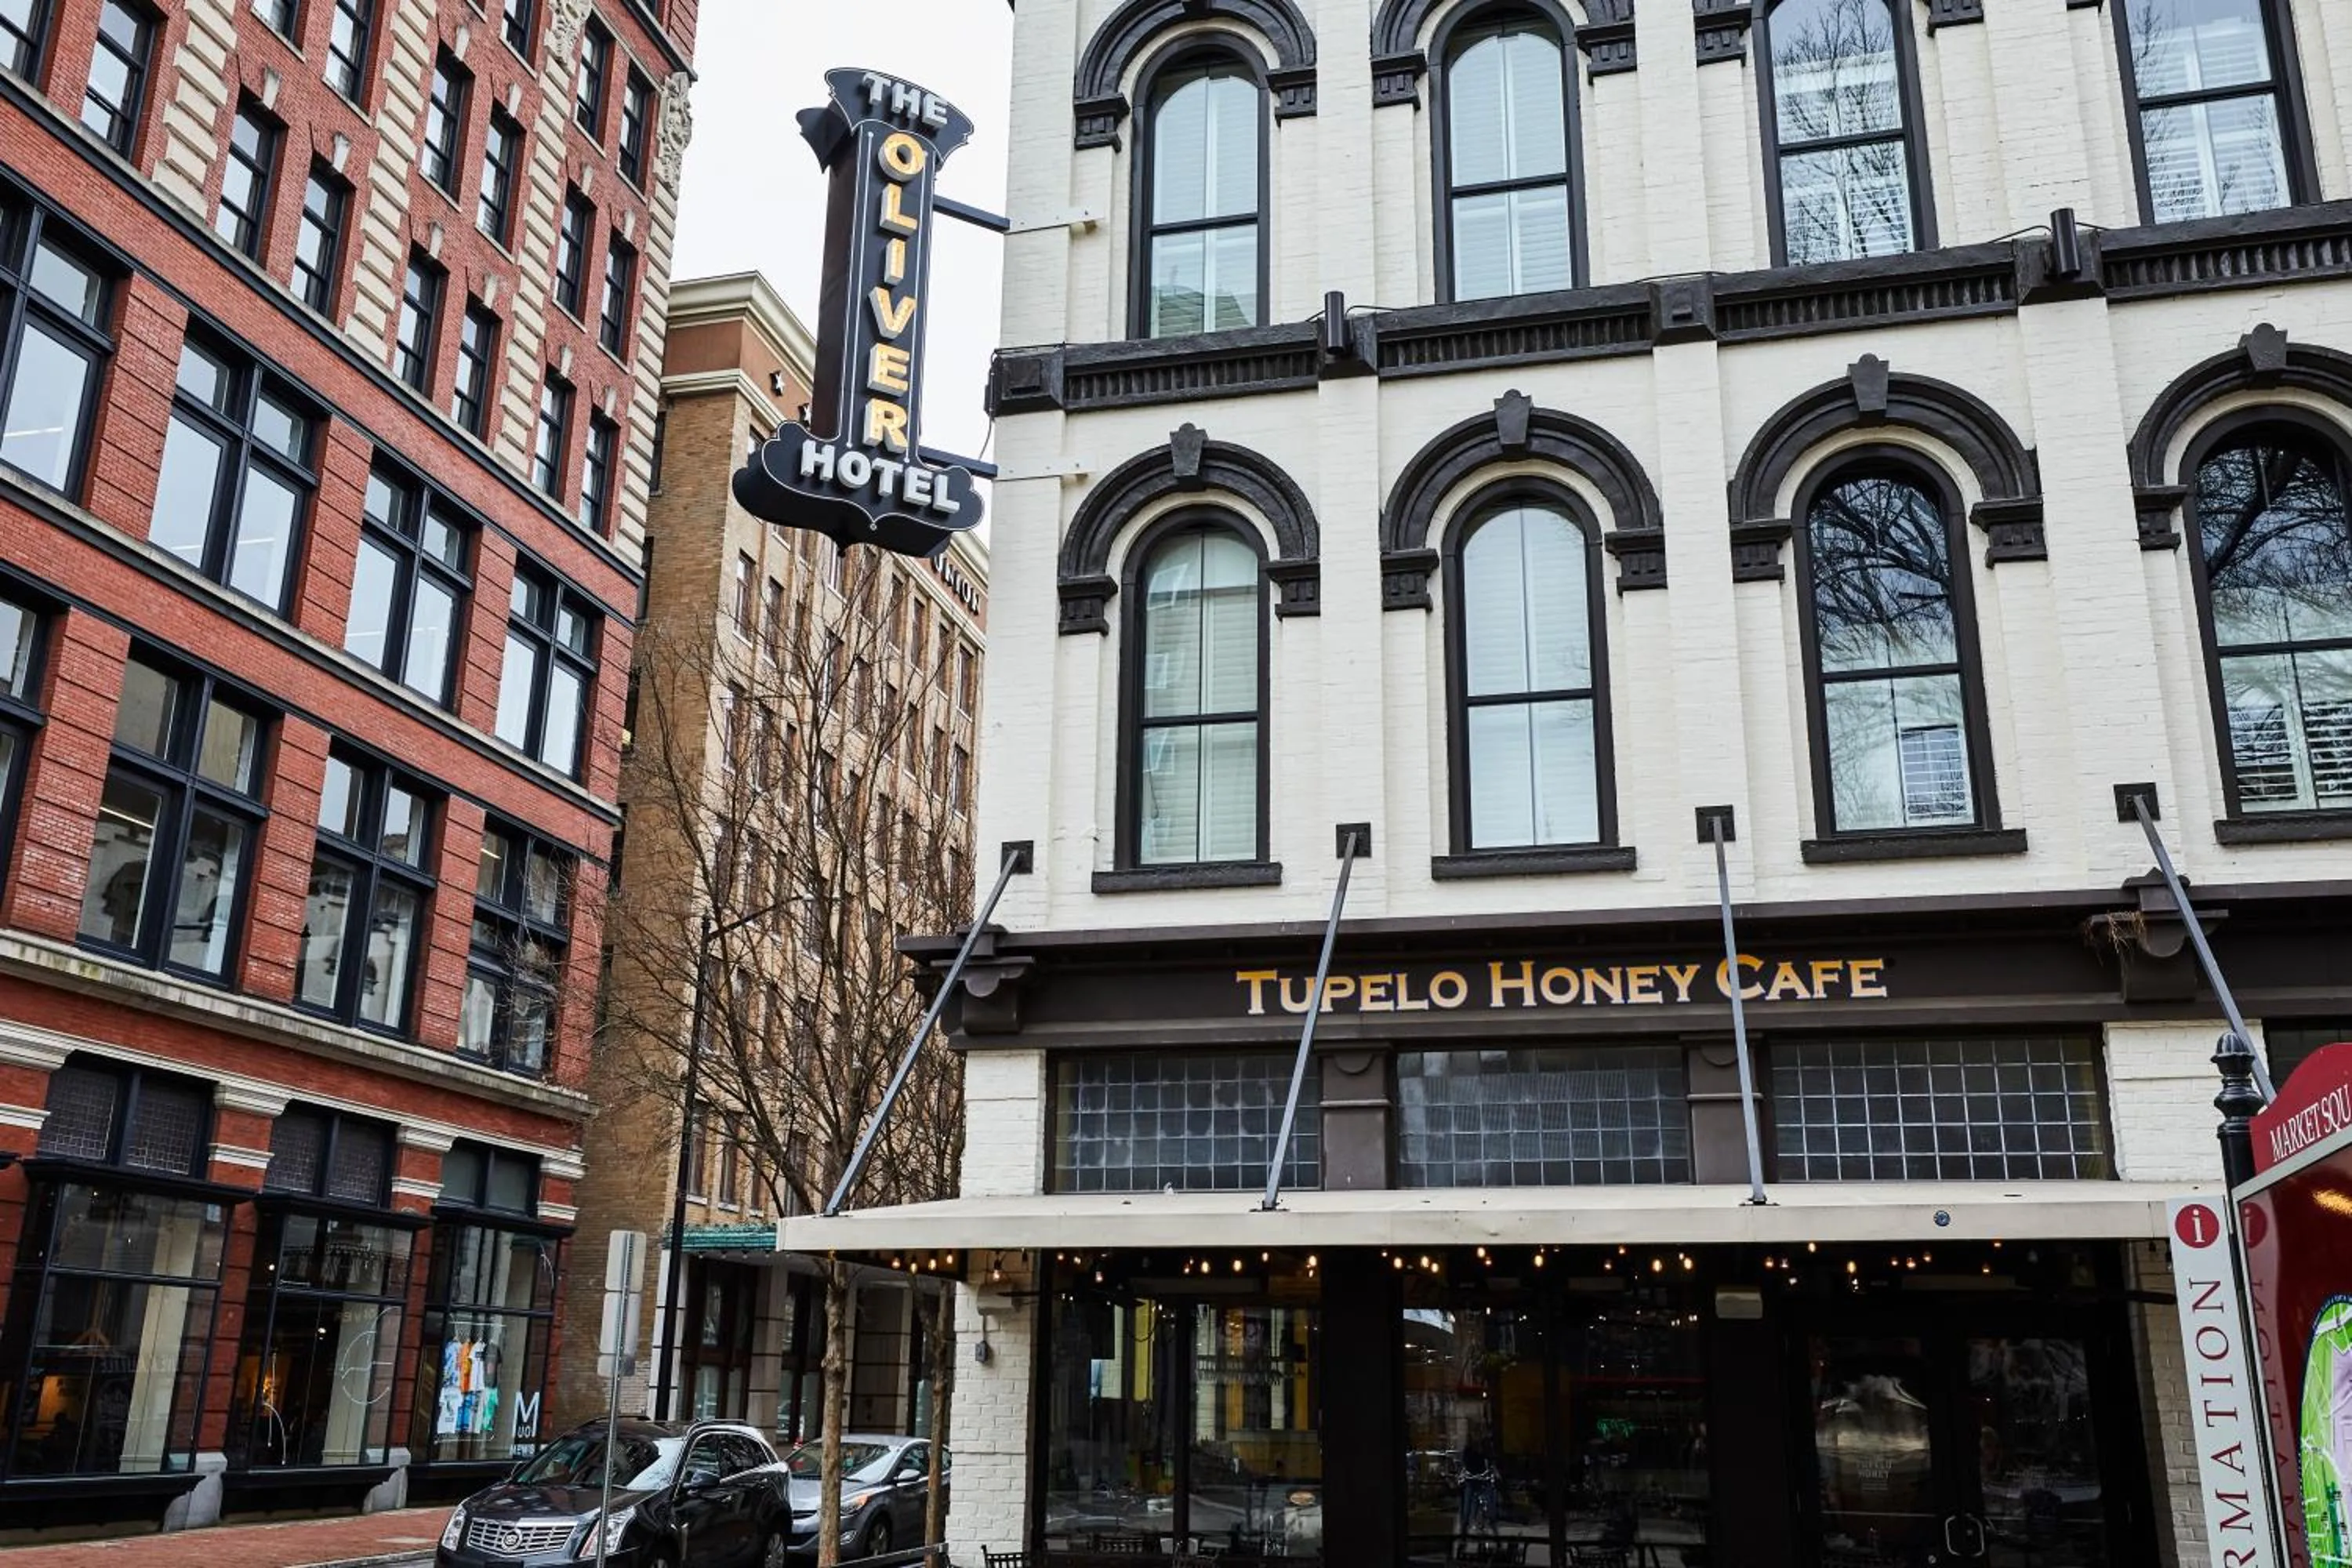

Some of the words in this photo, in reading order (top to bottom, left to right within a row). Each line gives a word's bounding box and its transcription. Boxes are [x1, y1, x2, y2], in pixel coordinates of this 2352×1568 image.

[862, 72, 948, 126] THE
[863, 132, 924, 452] OLIVER
[800, 439, 960, 514] HOTEL
[1236, 968, 1468, 1014] TUPELO
[1488, 960, 1700, 1007] HONEY
[1715, 953, 1887, 1001] CAFE
[2270, 1102, 2321, 1163] MARKET
